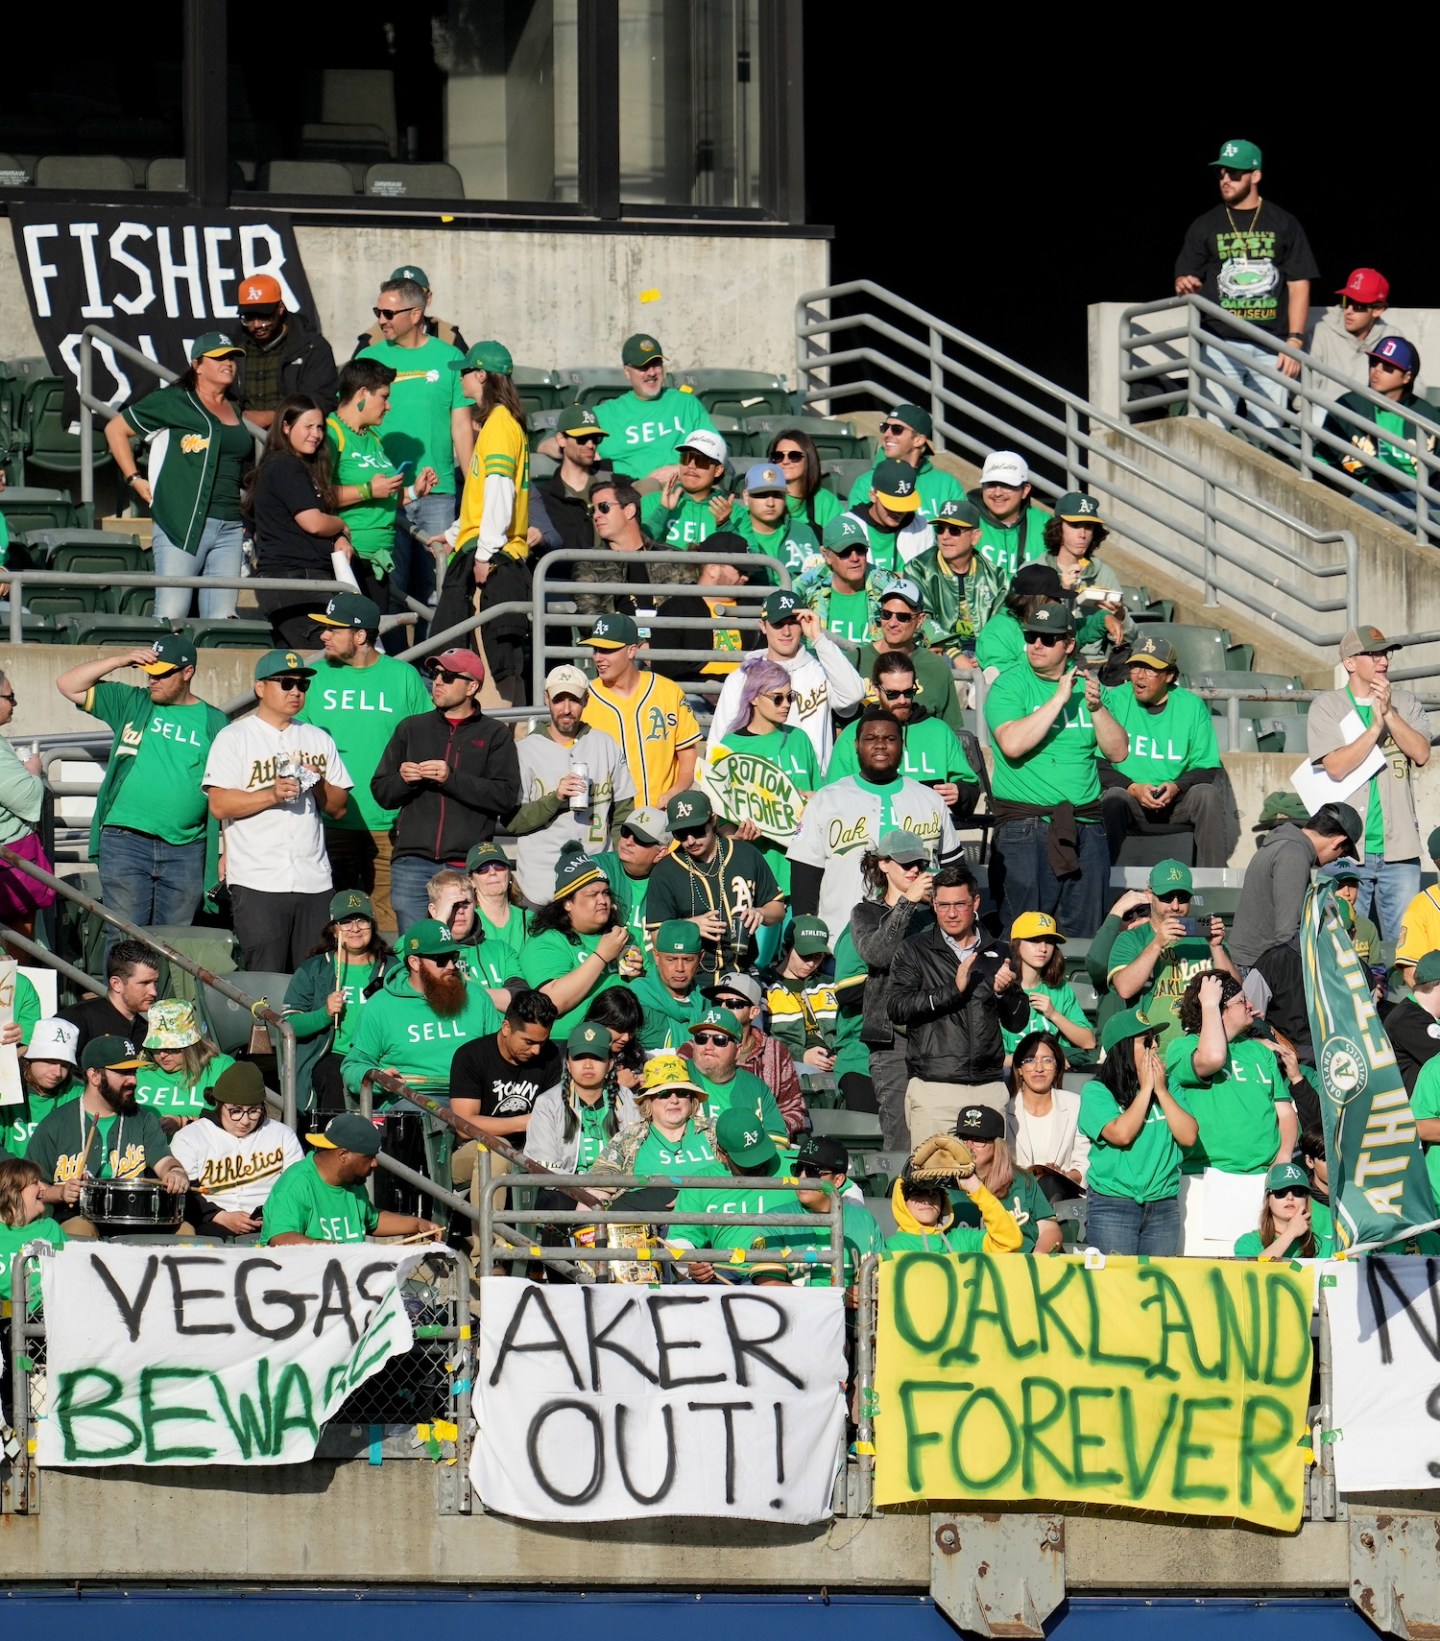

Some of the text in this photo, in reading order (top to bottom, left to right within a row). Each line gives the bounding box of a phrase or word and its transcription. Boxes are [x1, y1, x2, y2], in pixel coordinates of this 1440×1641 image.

[1217, 238, 1275, 251] LAST
[23, 222, 300, 319] FISHER
[1220, 298, 1278, 309] OAKLAND
[625, 416, 685, 444] SELL
[830, 622, 870, 641] ELL
[323, 689, 393, 713] SELL
[150, 717, 200, 746] SELL
[646, 708, 677, 742] A's
[728, 757, 792, 801] ROTTON
[734, 789, 797, 831] FISHER
[829, 816, 868, 846] Oak
[409, 1021, 465, 1042] SELL
[1322, 1051, 1342, 1098] OAKLAND
[137, 1086, 205, 1106] SELL
[493, 1080, 539, 1100] TOWN
[201, 1148, 283, 1184] Athletics
[660, 1143, 713, 1165] SELL
[319, 1217, 365, 1241] SEL
[893, 1251, 1311, 1387] OAKLAND
[489, 1285, 804, 1391] AKER
[528, 1399, 786, 1510] OUT!
[900, 1376, 1296, 1513] FOREVER
